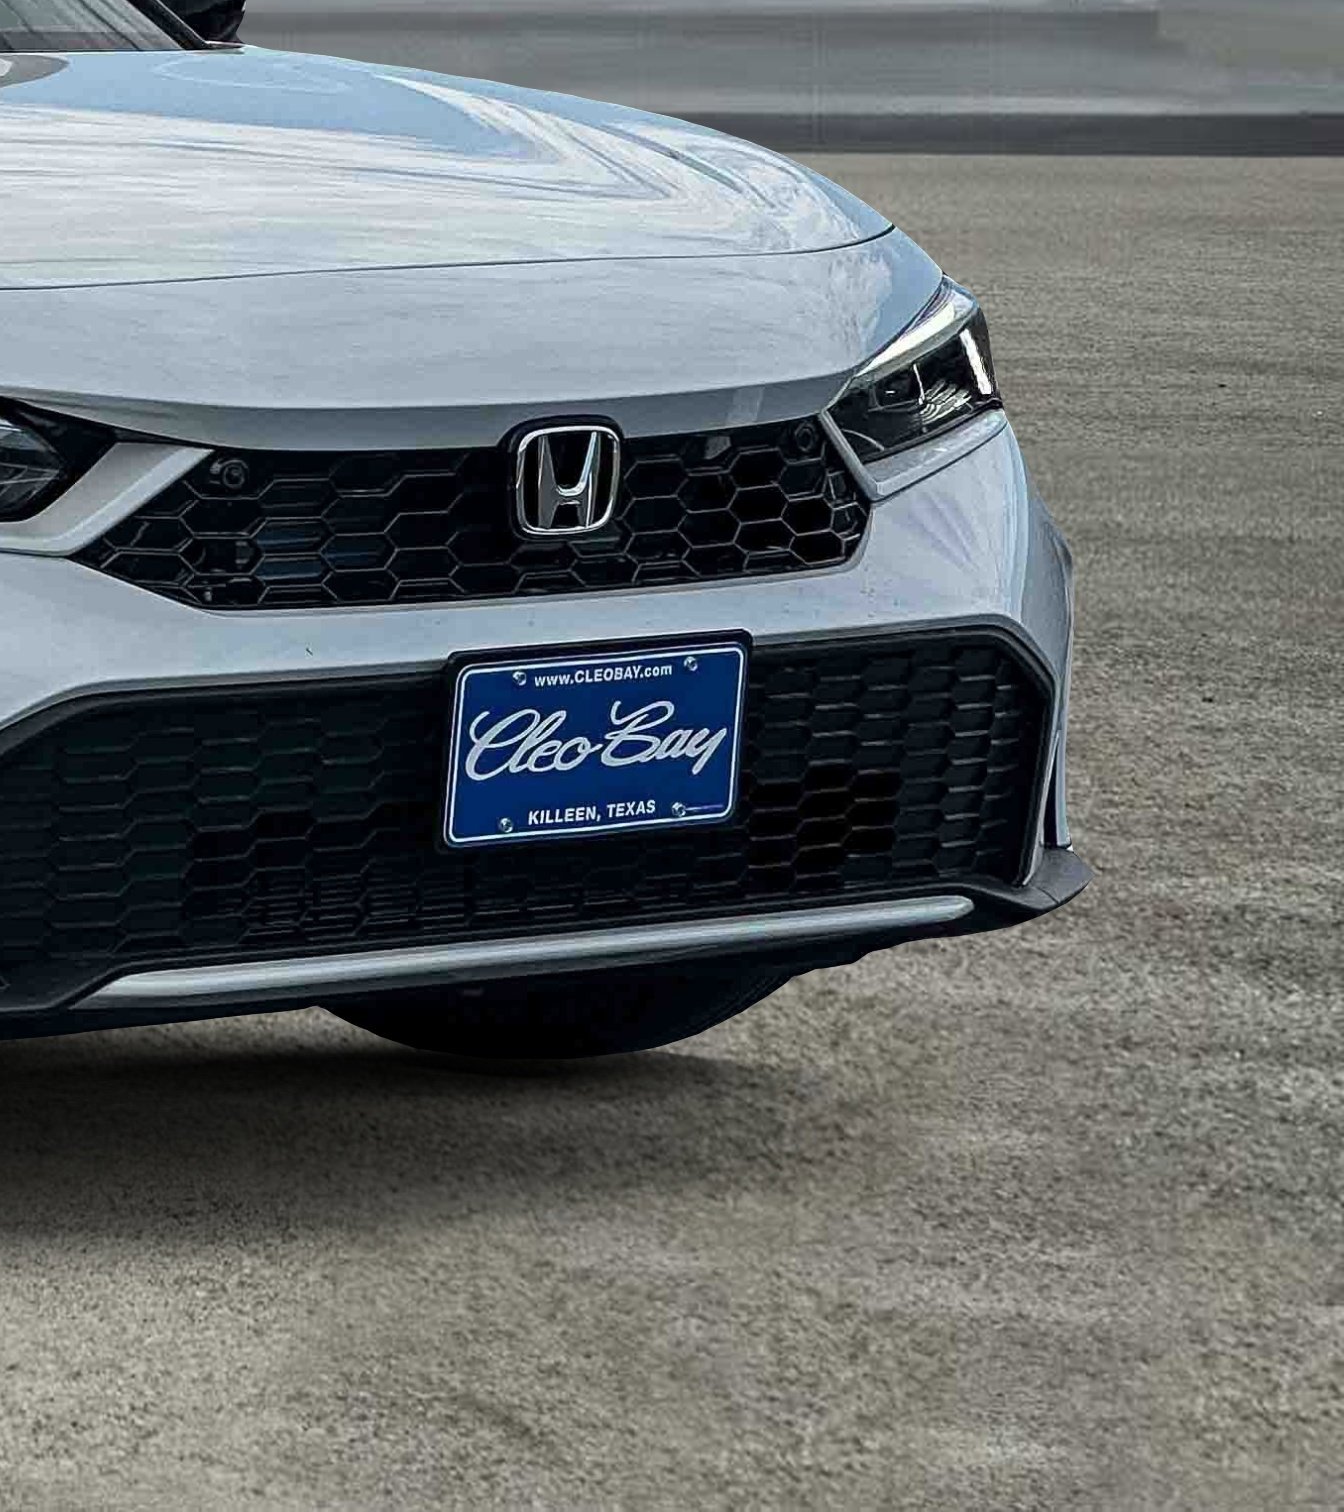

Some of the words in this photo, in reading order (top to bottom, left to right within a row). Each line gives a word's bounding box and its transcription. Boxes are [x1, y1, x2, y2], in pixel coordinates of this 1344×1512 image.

[534, 664, 673, 687] www.CLEOBAY.com
[465, 708, 602, 781] Cleo
[600, 700, 727, 775] Bay
[528, 805, 601, 826] KILLEEN,
[607, 799, 656, 819] TEXAS
